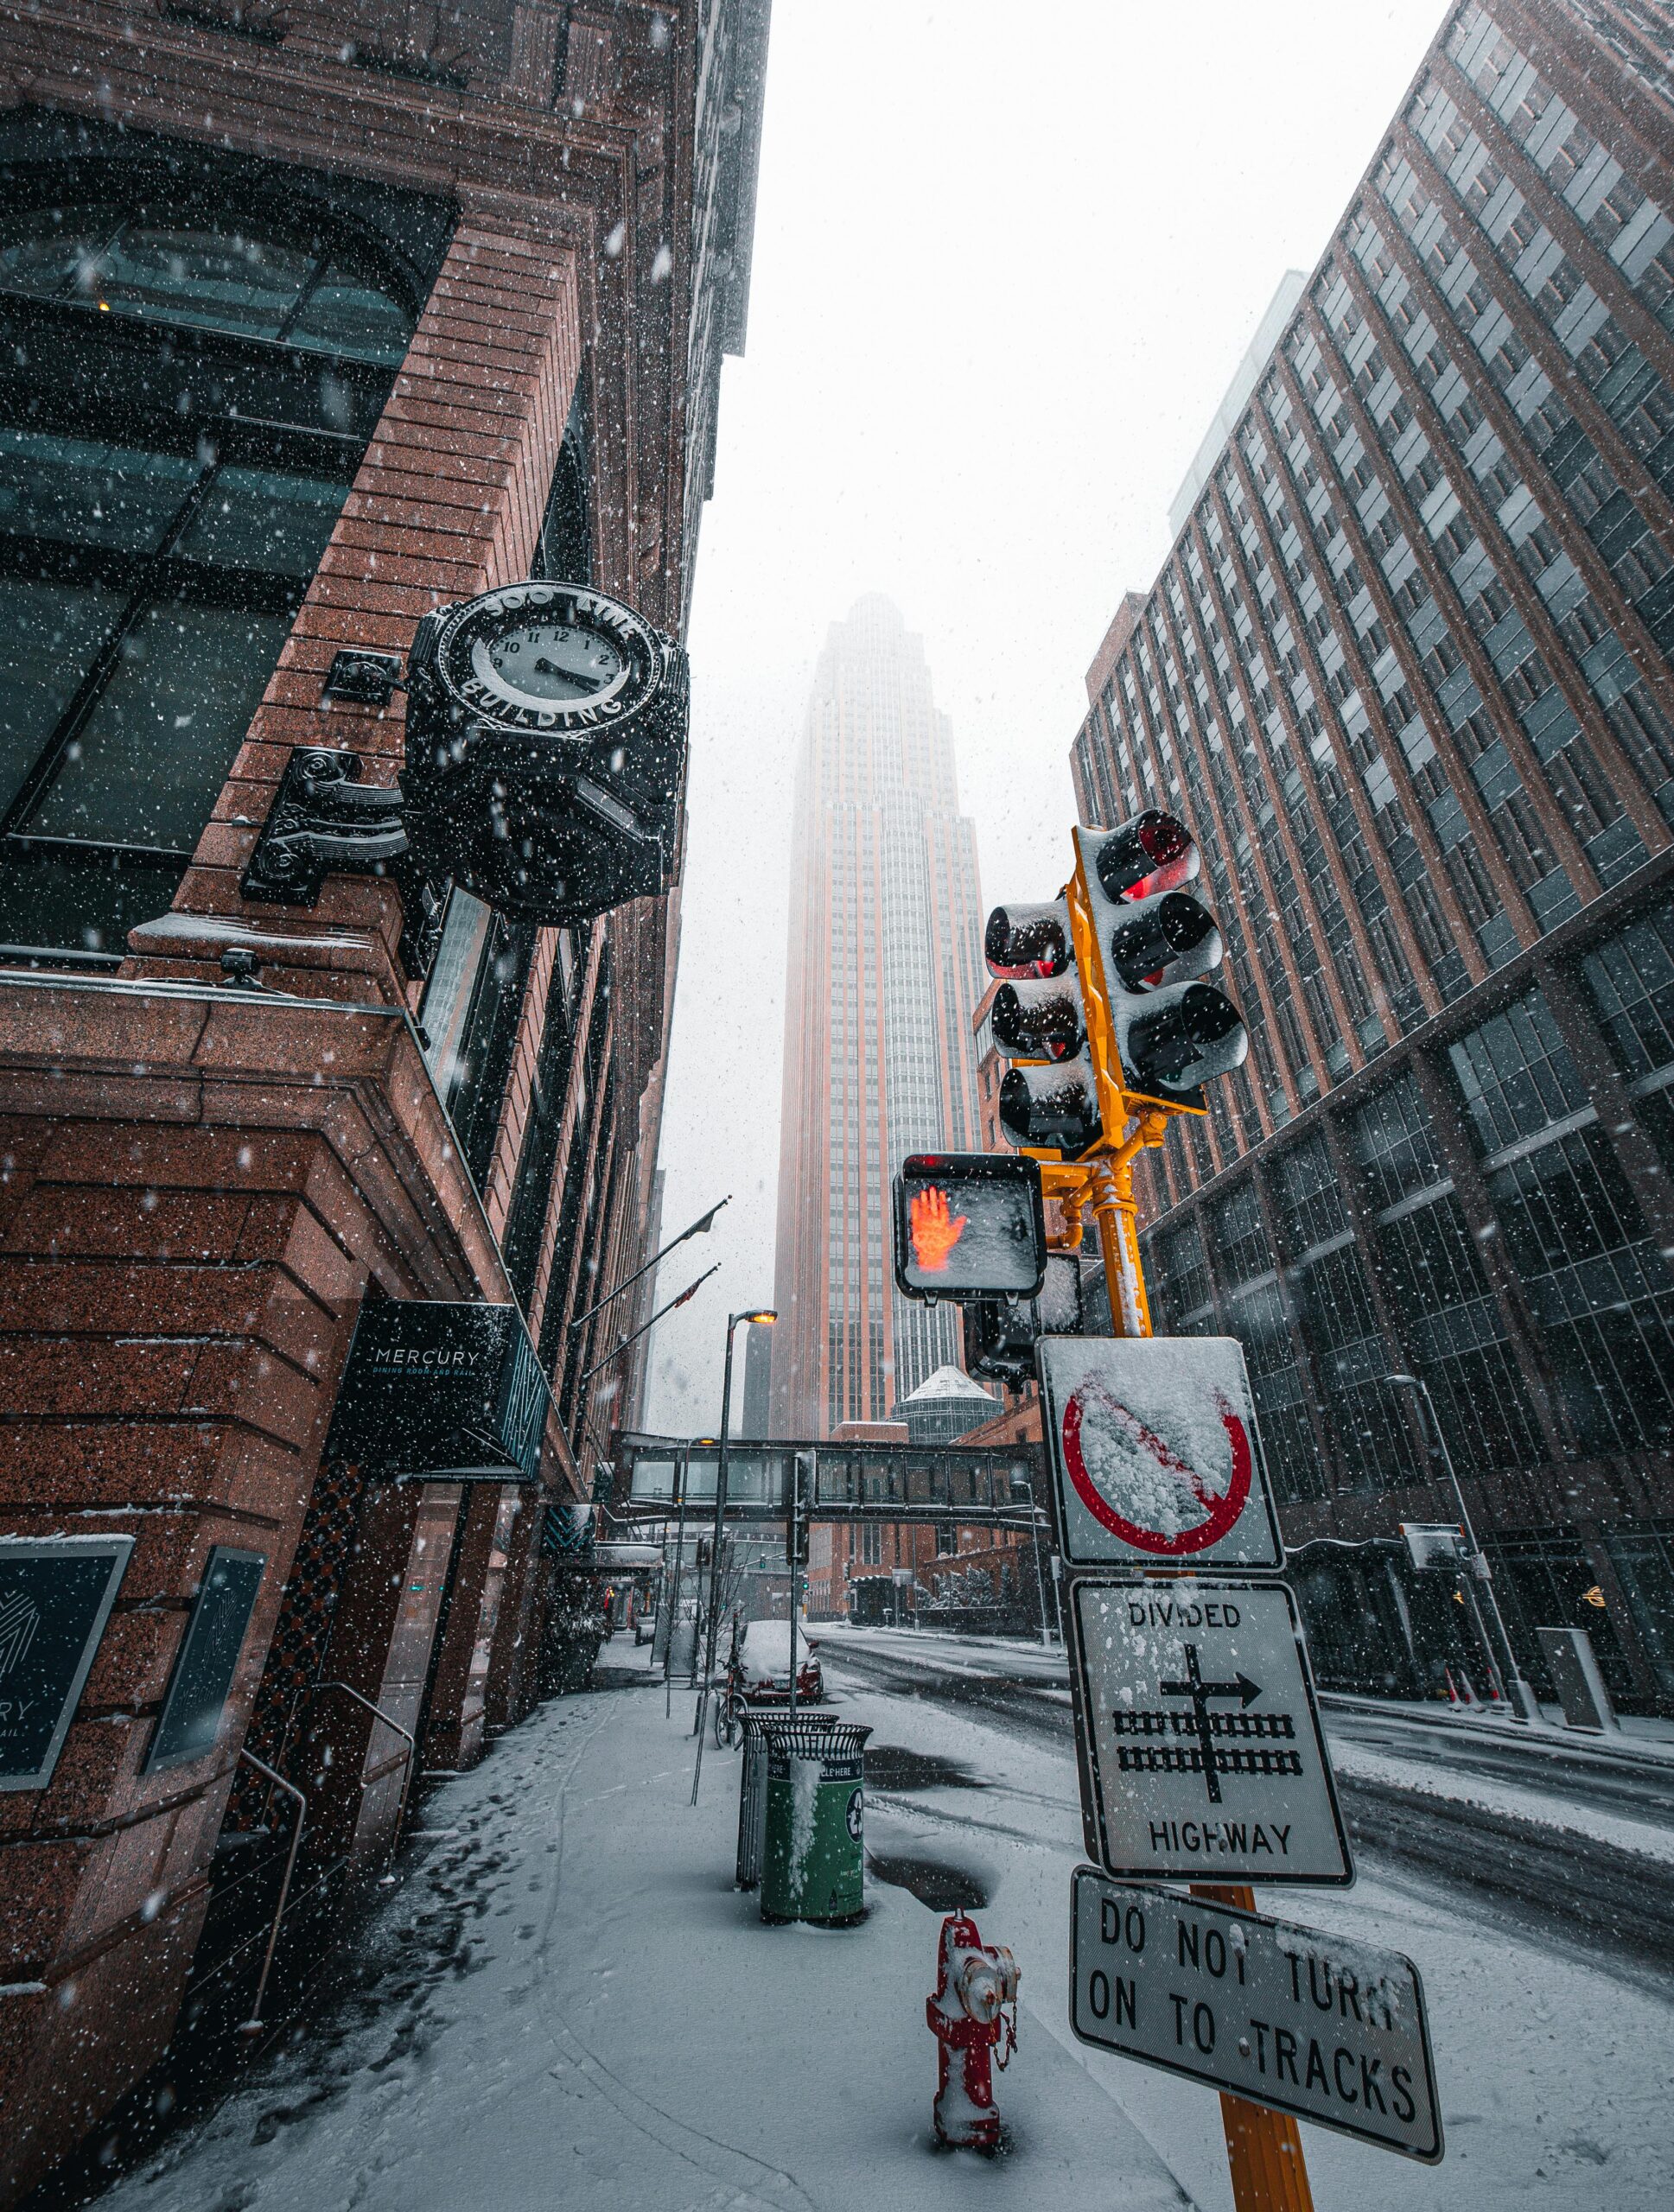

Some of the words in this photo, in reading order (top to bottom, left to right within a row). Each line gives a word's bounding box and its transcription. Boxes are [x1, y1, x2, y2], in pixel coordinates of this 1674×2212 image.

[484, 588, 555, 616] SOO
[527, 632, 540, 643] 11
[553, 631, 570, 643] 12
[583, 639, 591, 650] 1
[503, 641, 520, 653] 10
[492, 658, 503, 669] 9
[598, 654, 610, 665] 2
[603, 673, 615, 684] 3
[461, 677, 622, 728] BUILDING
[375, 1348, 480, 1365] MERCURY
[1129, 1602, 1241, 1628] DIVIDED
[0, 1700, 35, 1721] RY
[1149, 1821, 1291, 1855] HIGHWAY
[1102, 1897, 1146, 1953] DO
[1089, 1969, 1136, 2031] ON
[1169, 1993, 1216, 2055] TO
[1250, 2018, 1416, 2124] TRACKS
